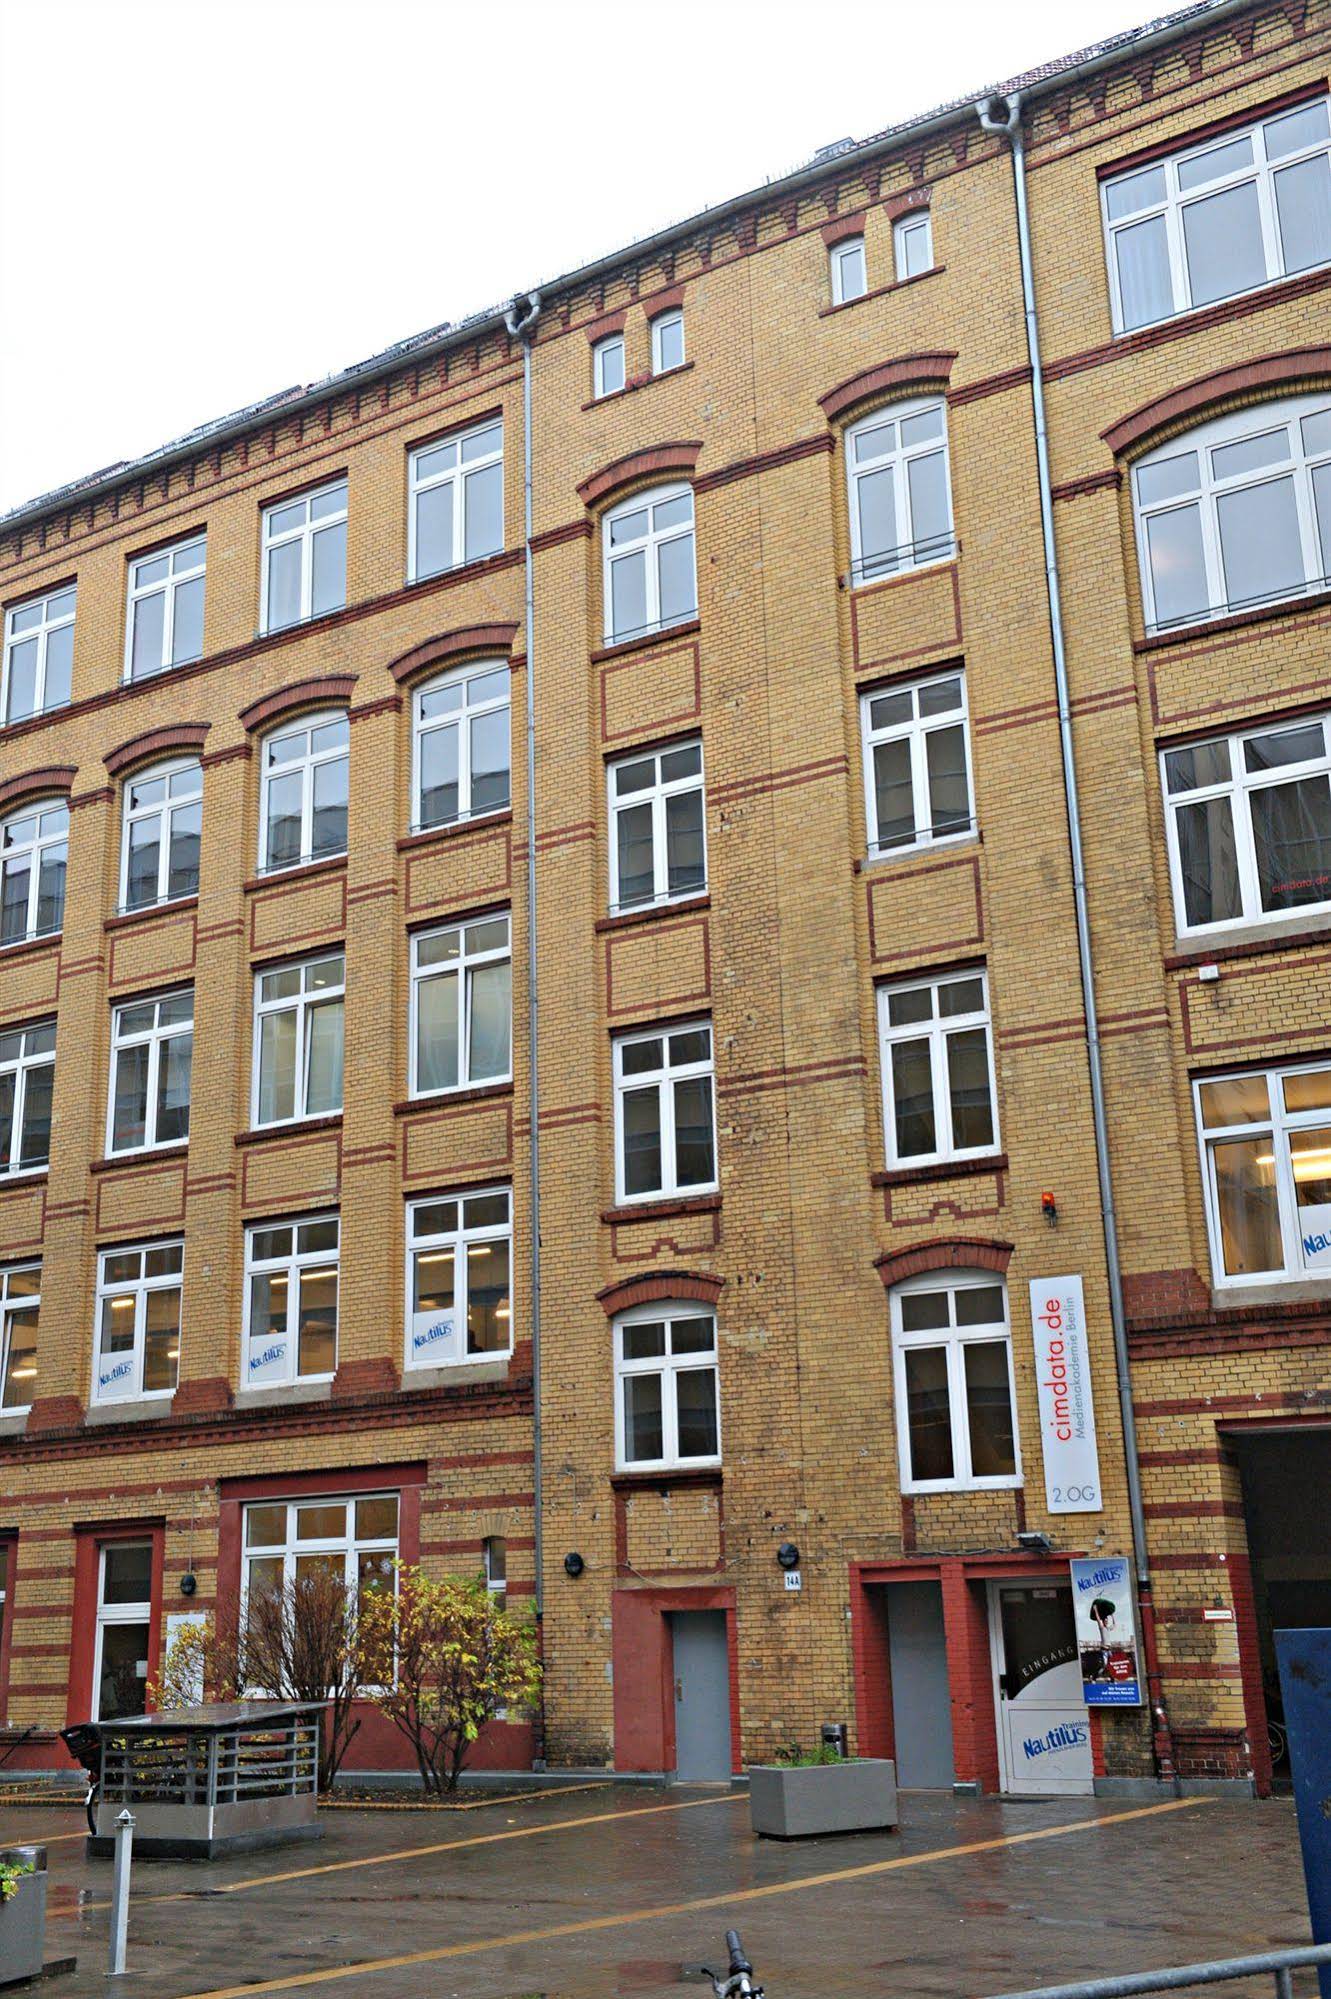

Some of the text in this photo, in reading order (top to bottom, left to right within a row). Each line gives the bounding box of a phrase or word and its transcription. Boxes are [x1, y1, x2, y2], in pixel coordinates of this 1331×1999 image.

[413, 1325, 453, 1349] Nautilus
[250, 1347, 285, 1372] Nautilus
[1038, 1299, 1072, 1441] cimdata.de
[1063, 1297, 1086, 1440] Medienakademie Berlin
[100, 1364, 132, 1387] Nautilus
[1053, 1485, 1096, 1503] 2.OG
[786, 1575, 800, 1587] 14A
[1077, 1567, 1121, 1592] Nautilus
[1021, 1645, 1074, 1677] EINGANG
[1023, 1727, 1087, 1760] Nautilus
